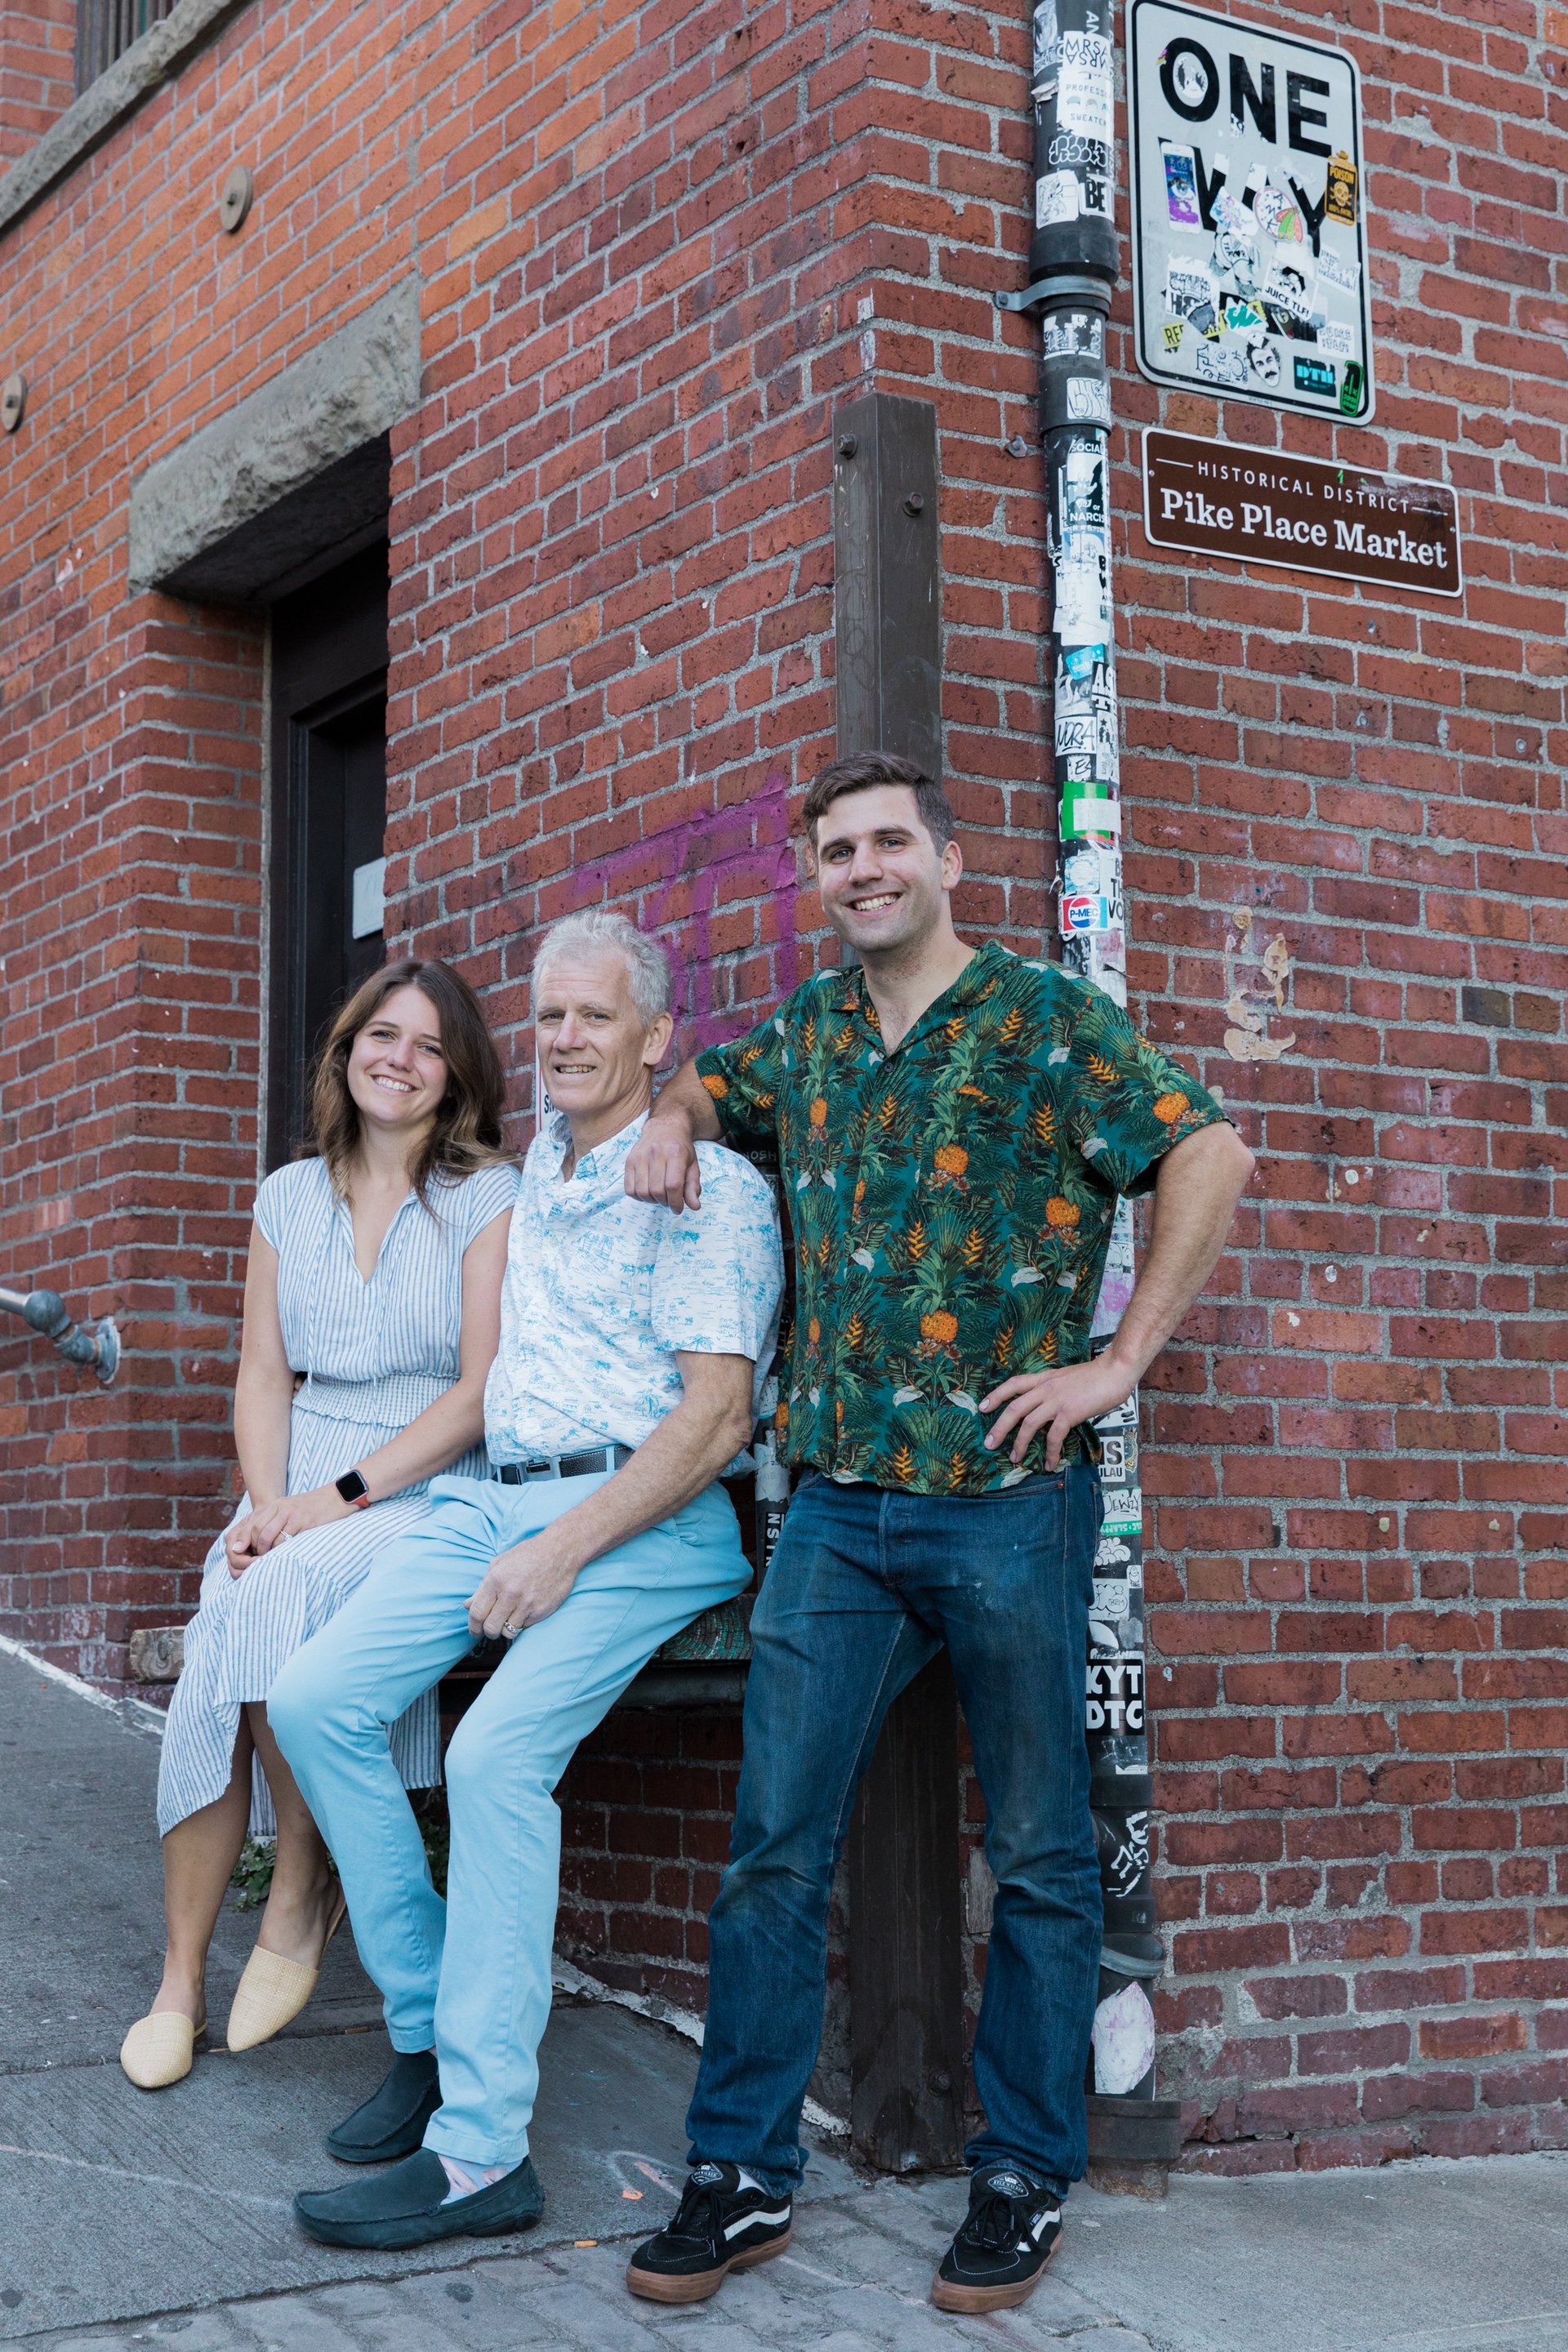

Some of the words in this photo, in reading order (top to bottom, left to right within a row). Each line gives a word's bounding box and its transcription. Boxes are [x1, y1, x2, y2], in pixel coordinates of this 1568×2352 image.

[1159, 37, 1333, 157] ONE
[1157, 137, 1329, 258] WY
[1329, 166, 1355, 185] POISON
[1265, 286, 1290, 306] JUICE
[1197, 461, 1314, 497] HISTORICAL
[1324, 484, 1410, 514] DISTRICT
[1160, 487, 1234, 530] Pike
[1240, 502, 1328, 546] Place
[1334, 519, 1449, 568] Market
